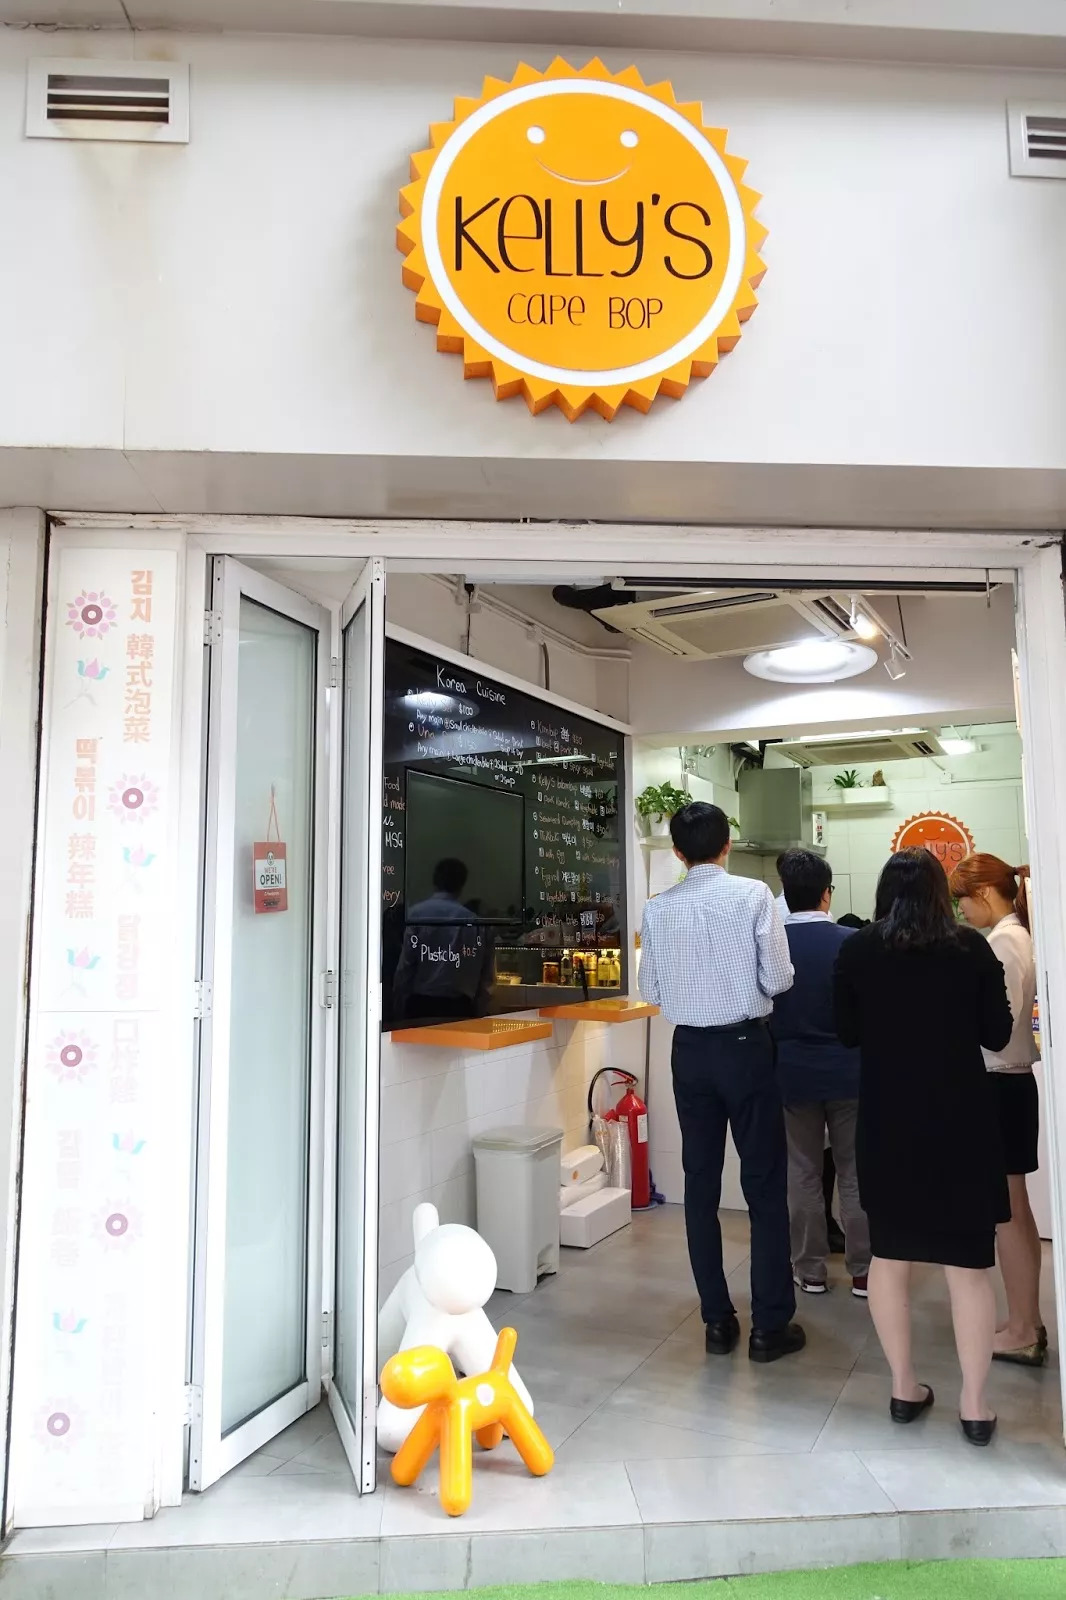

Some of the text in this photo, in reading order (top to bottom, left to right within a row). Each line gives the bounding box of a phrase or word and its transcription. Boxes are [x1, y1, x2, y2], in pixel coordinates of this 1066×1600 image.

[608, 296, 663, 329] BOP
[123, 633, 155, 743] 韓式泡菜
[436, 664, 506, 705] Korea Cuisine
[383, 776, 400, 791] Food
[385, 832, 403, 848] MSG
[64, 832, 97, 919] 辣年糕
[259, 873, 282, 886] OPEN!
[420, 943, 448, 963] Plastic
[448, 945, 461, 968] bag
